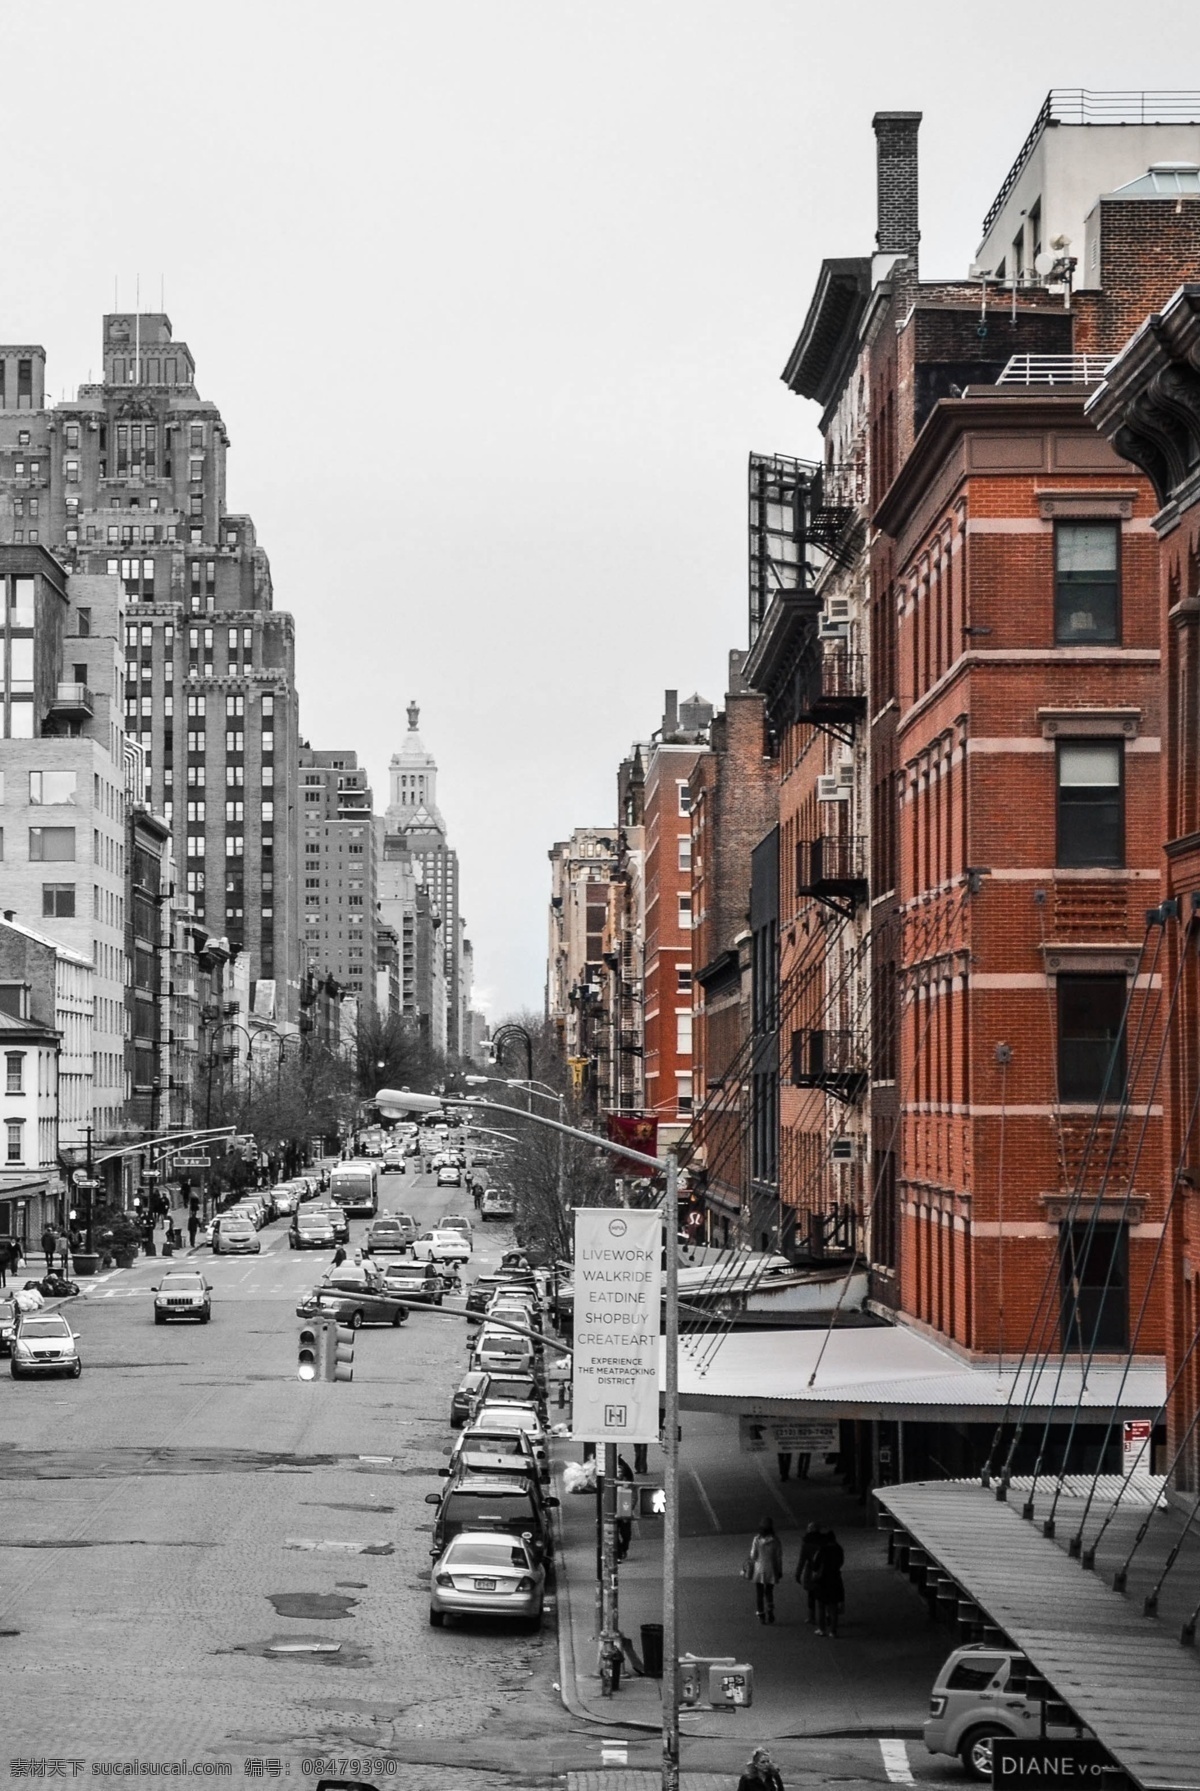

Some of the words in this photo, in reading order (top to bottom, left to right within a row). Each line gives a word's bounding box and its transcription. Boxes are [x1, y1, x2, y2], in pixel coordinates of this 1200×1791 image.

[582, 1249, 654, 1262] LIVEWORK
[582, 1270, 653, 1283] WALKRIDE
[589, 1291, 646, 1304] EATDINE
[585, 1312, 649, 1325] SHOPBUY
[578, 1333, 656, 1346] CREATEART
[591, 1357, 643, 1366] EXPERIENCE
[578, 1366, 594, 1375] THE
[596, 1367, 656, 1376] MEATPACKING
[598, 1377, 636, 1385] DISTRICT
[1002, 1756, 1075, 1775] DIANE
